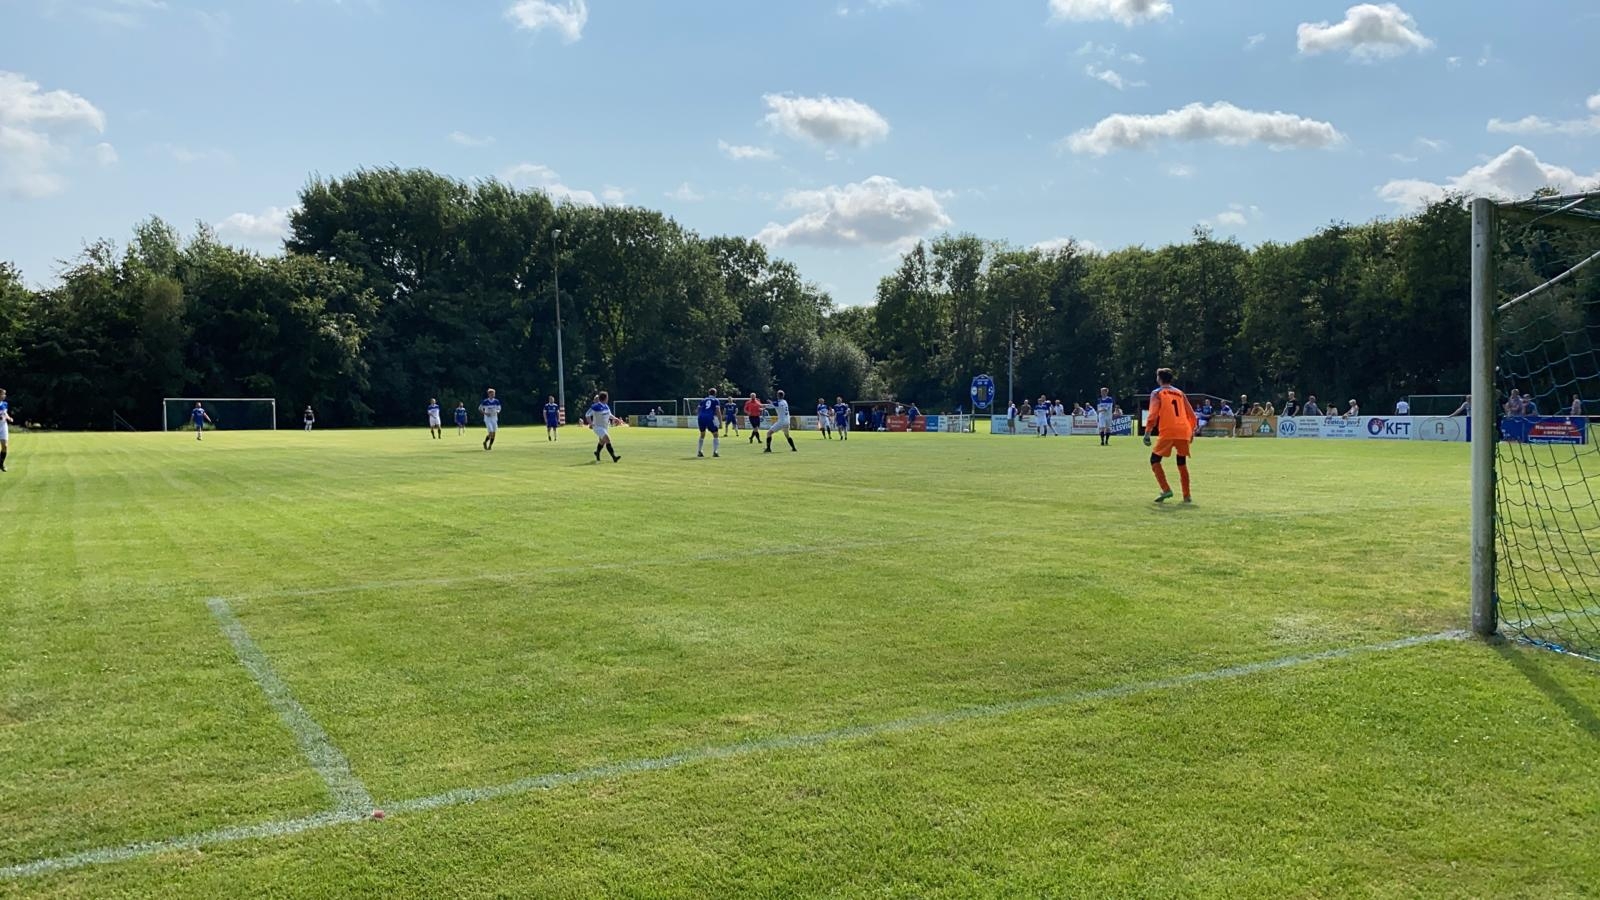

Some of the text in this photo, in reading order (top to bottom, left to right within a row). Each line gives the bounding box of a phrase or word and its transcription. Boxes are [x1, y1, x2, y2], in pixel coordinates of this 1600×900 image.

[705, 399, 712, 409] 9
[1171, 399, 1180, 417] 1
[1386, 422, 1411, 435] KFT
